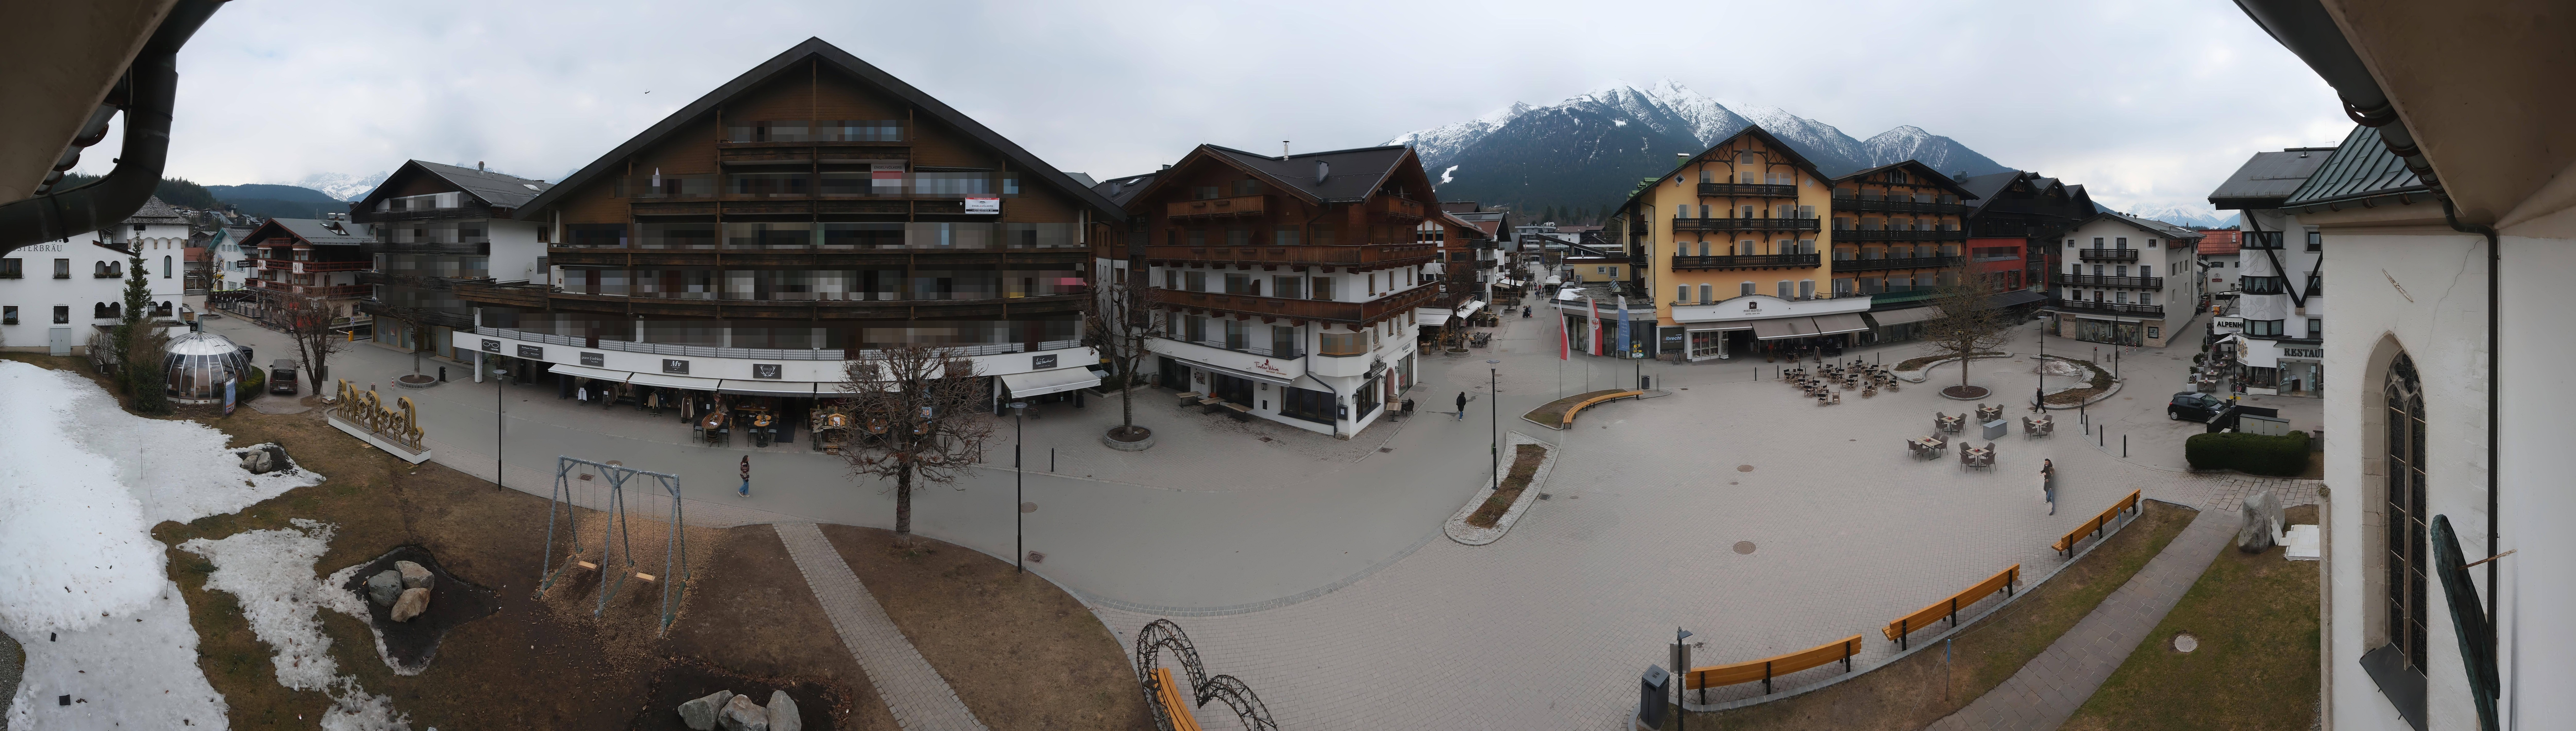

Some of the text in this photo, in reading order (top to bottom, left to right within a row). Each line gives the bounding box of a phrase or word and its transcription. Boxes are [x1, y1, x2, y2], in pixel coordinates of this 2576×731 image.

[1402, 343, 1410, 352] SAILER
[2238, 355, 2248, 365] Kaltschmid
[1372, 364, 1386, 377] RESTAURANT
